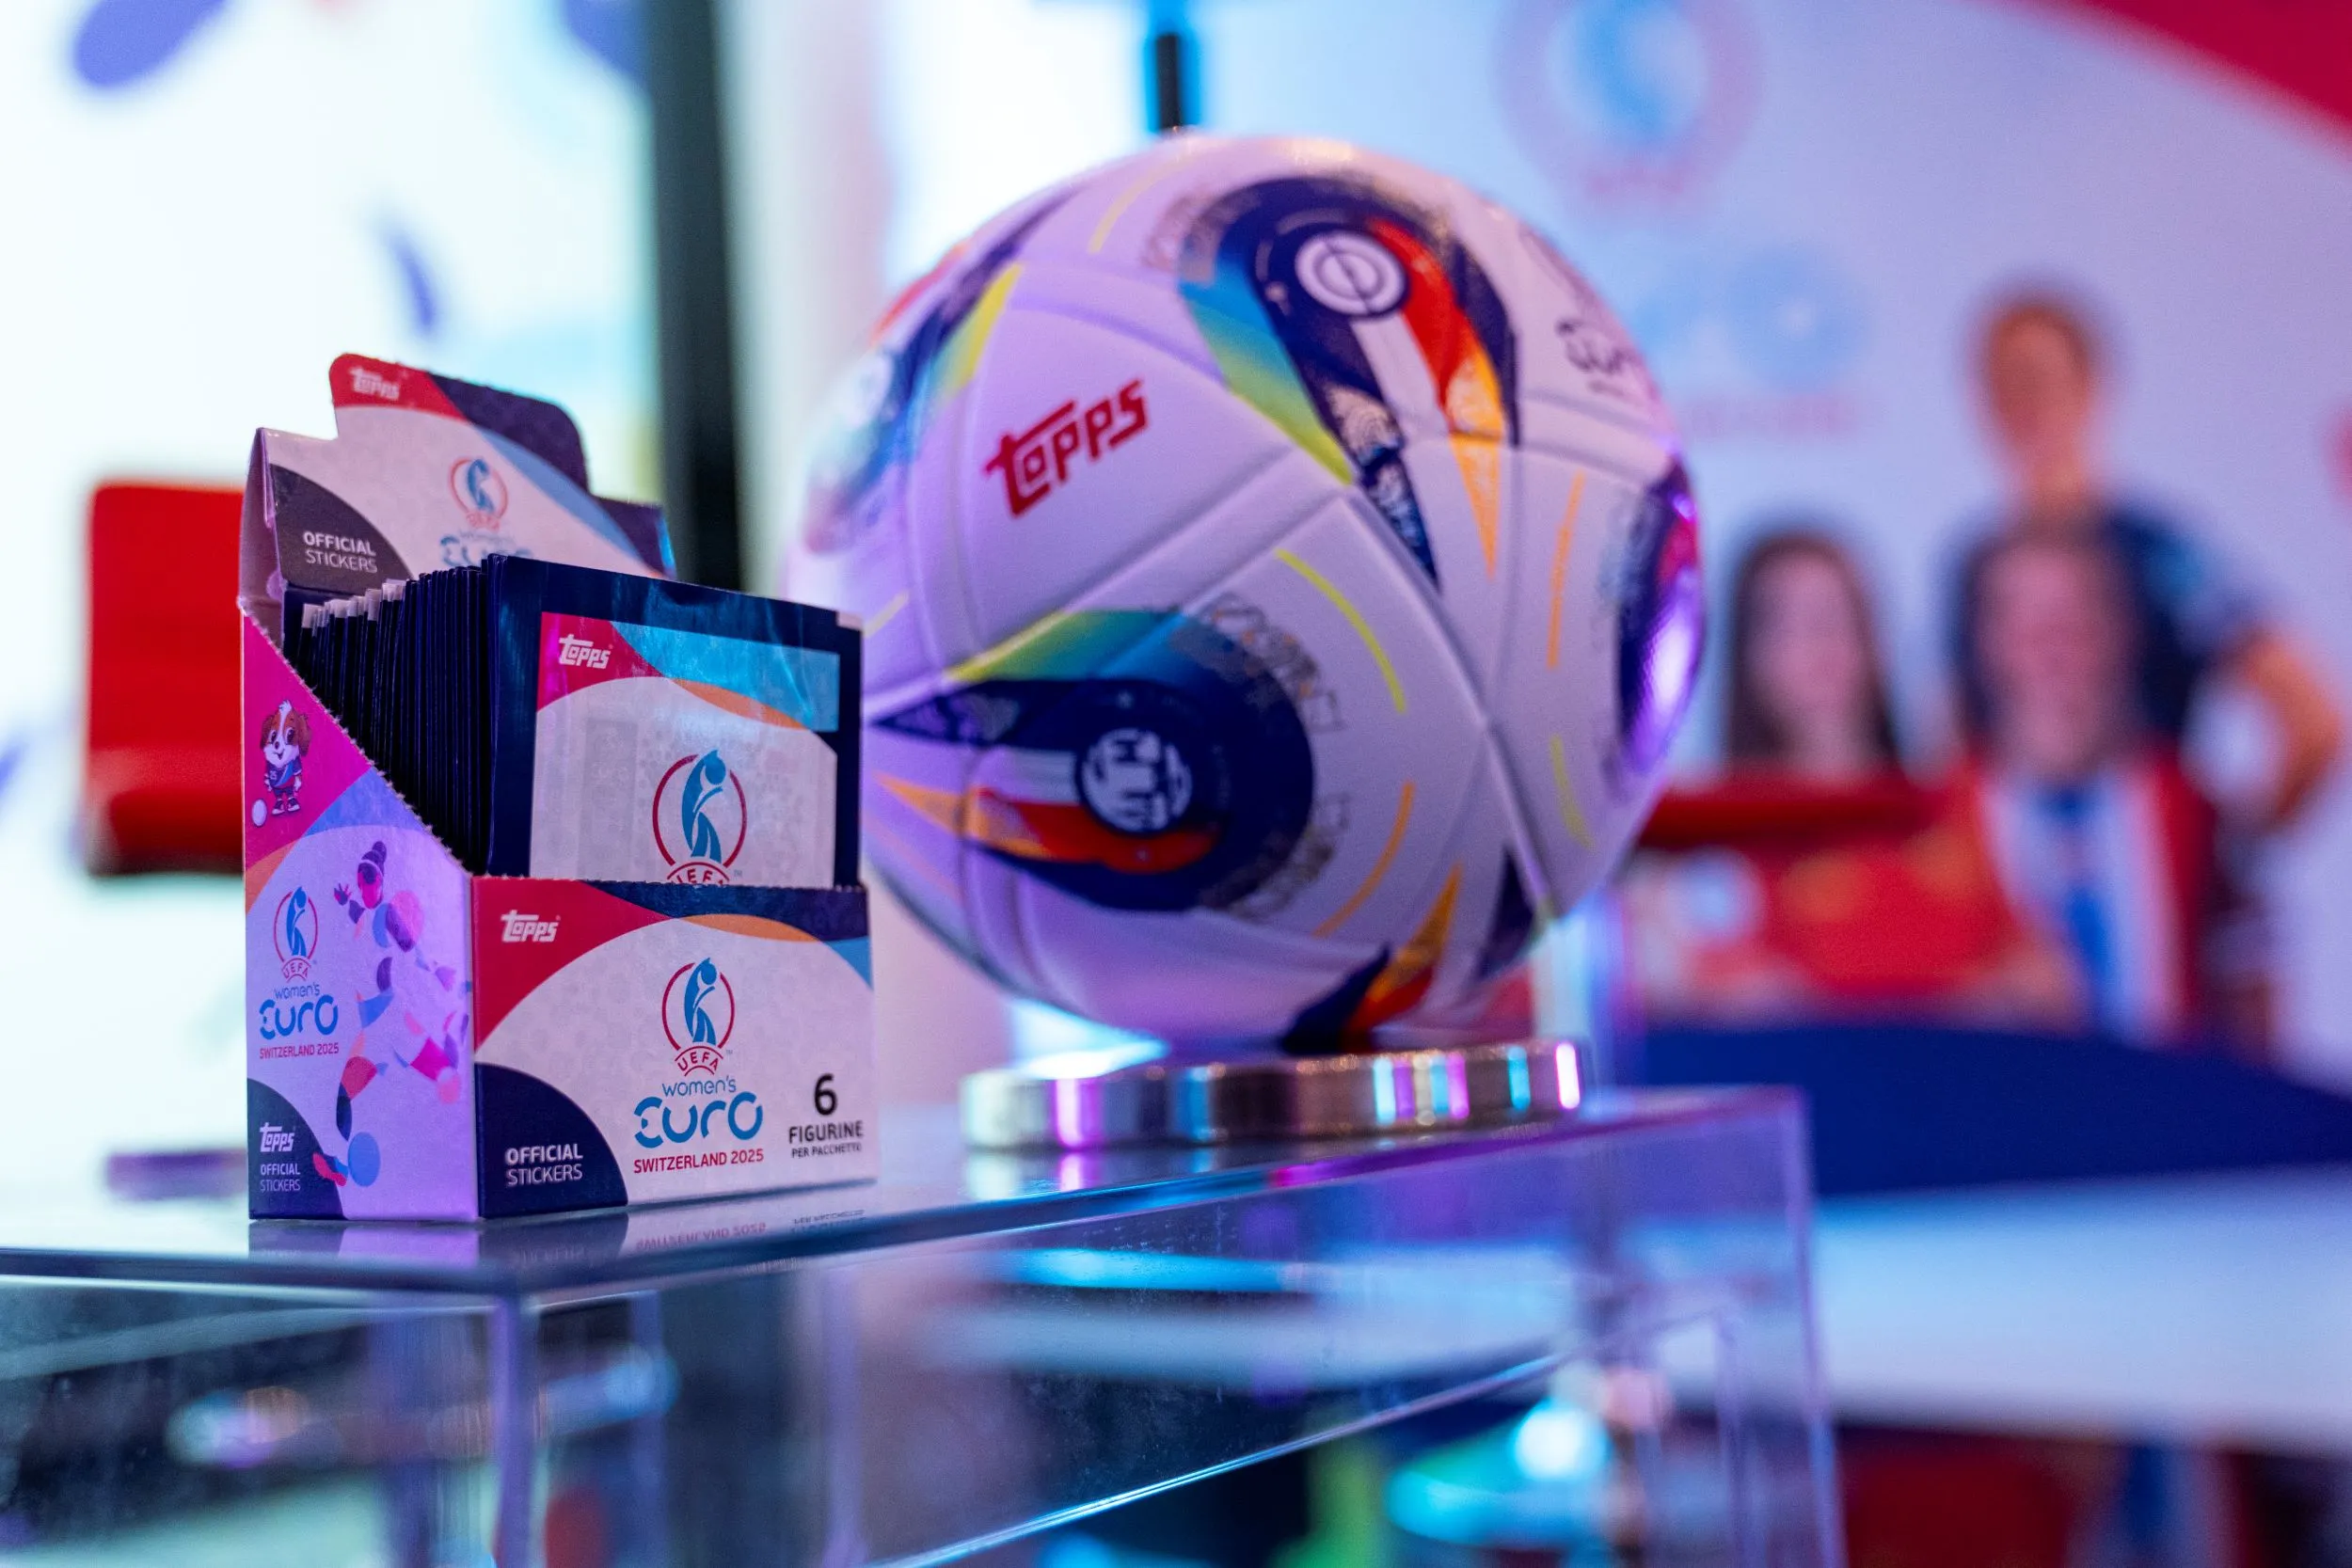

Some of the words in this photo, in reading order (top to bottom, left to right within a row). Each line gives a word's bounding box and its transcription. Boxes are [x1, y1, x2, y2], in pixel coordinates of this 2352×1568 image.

[303, 531, 377, 558] OFFICIAL
[305, 547, 378, 574] STICKERS
[282, 961, 310, 979] UEFA
[275, 982, 321, 999] women's
[259, 1043, 315, 1060] SWITZERLAND
[317, 1041, 340, 1055] 2025
[676, 1051, 719, 1071] UEFA
[661, 1074, 737, 1098] women's
[813, 1071, 838, 1117] 6
[787, 1119, 865, 1145] FIGURINE
[504, 1143, 584, 1166] OFFICIAL
[634, 1152, 727, 1174] SWITZERLAND
[731, 1148, 765, 1164] 2025
[791, 1146, 810, 1159] PER
[811, 1141, 863, 1157] PACCHETTO
[260, 1162, 301, 1176] OFFICIAL
[505, 1163, 583, 1187] STICKERS
[260, 1179, 301, 1193] STICKERS
